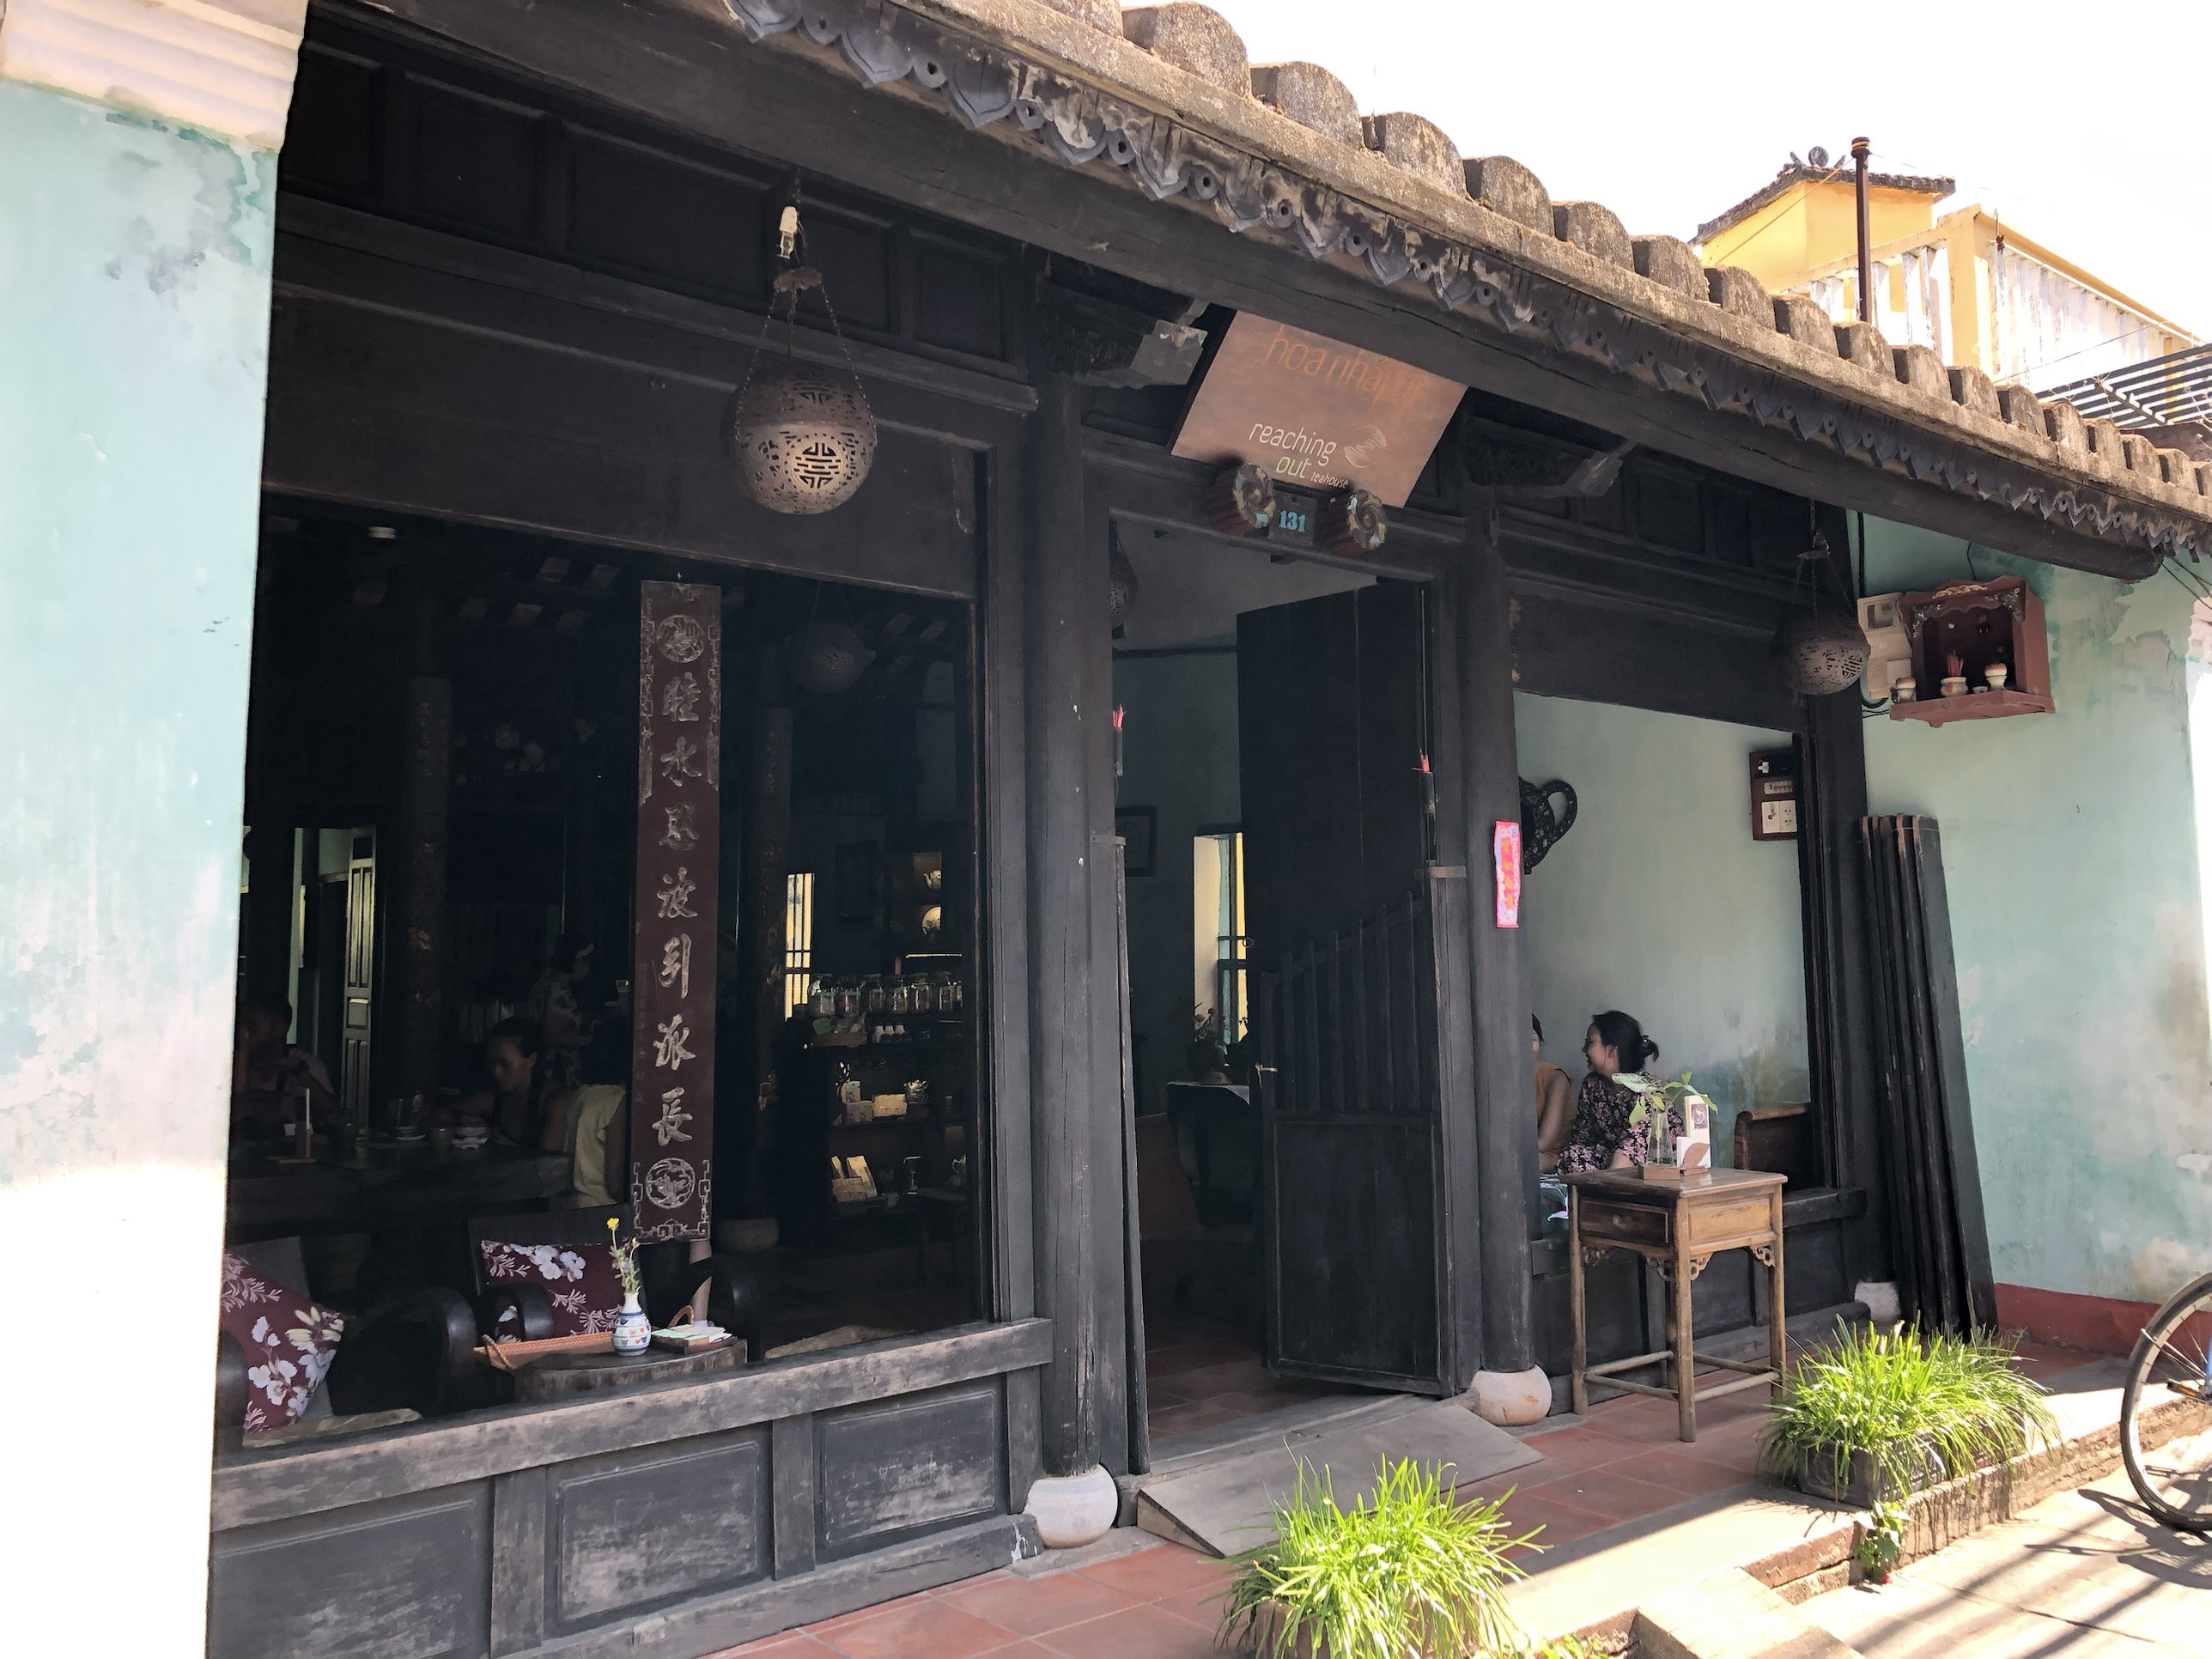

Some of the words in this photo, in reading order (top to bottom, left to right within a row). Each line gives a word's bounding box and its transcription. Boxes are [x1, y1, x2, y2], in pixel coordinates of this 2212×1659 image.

[1249, 422, 1337, 467] reaching
[1276, 456, 1312, 479] out
[1310, 471, 1349, 489] teahouse
[1278, 510, 1307, 533] 131
